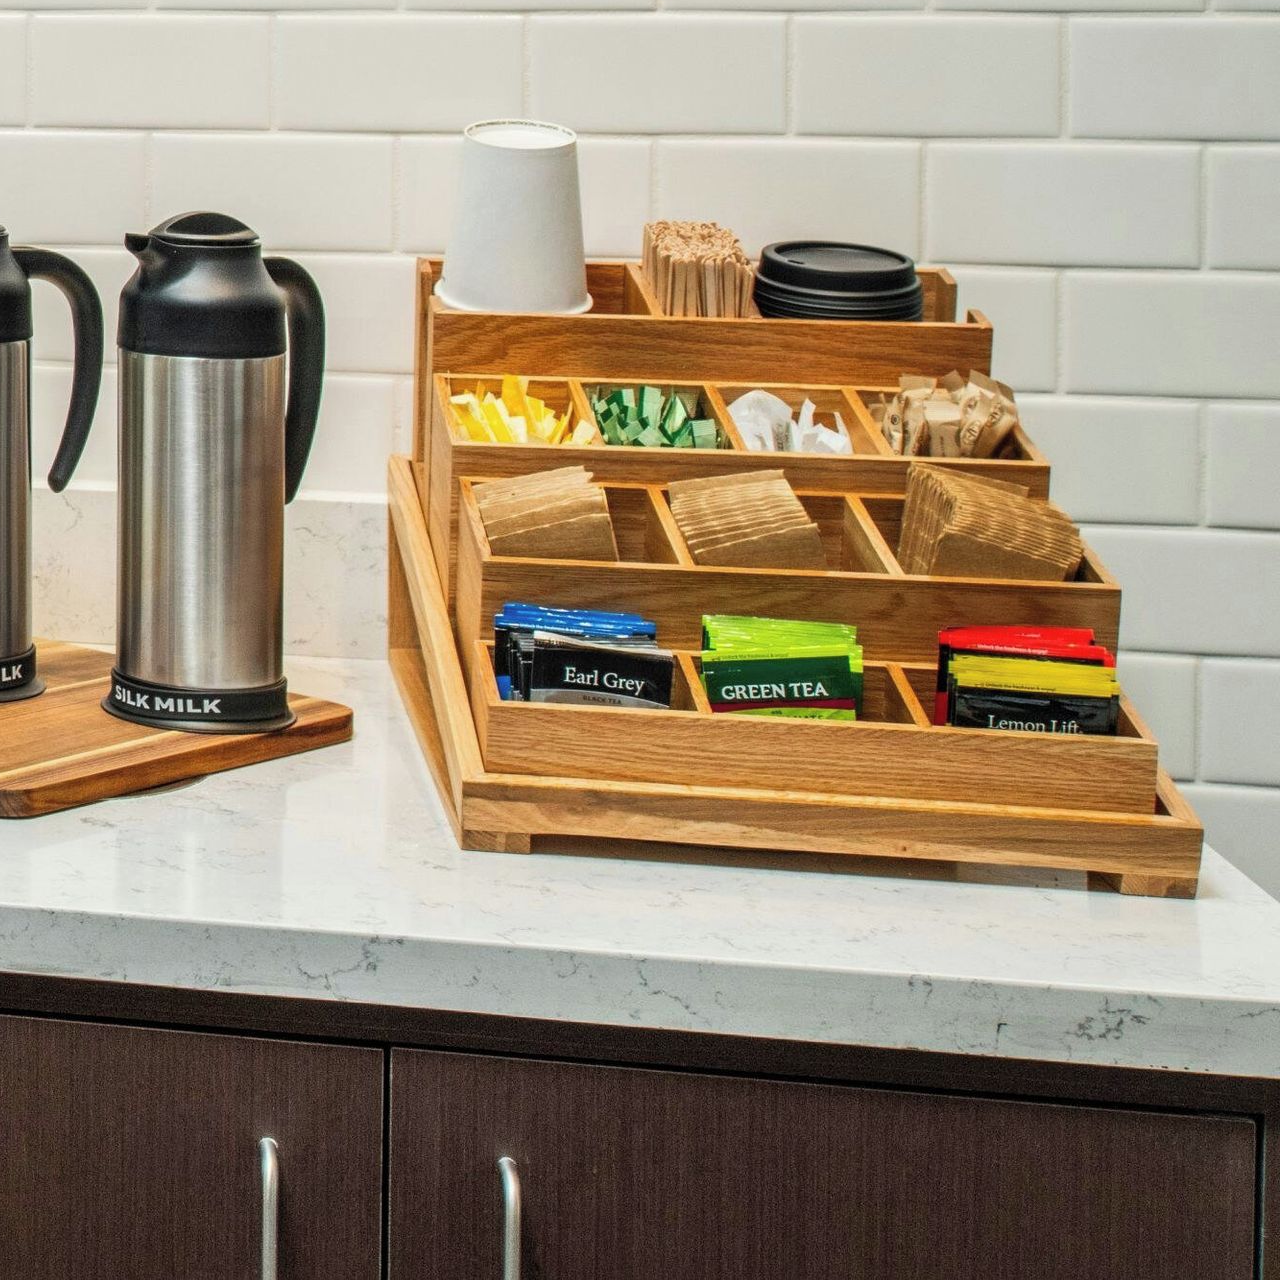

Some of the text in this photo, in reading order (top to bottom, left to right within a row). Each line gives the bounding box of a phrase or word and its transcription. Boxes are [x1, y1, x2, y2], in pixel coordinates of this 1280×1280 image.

[563, 666, 646, 695] Earl Grey
[114, 684, 222, 714] SILK MILK
[582, 694, 622, 705] BLACK TEA
[721, 681, 829, 700] GREEN TEA
[988, 714, 1046, 733] Lemon
